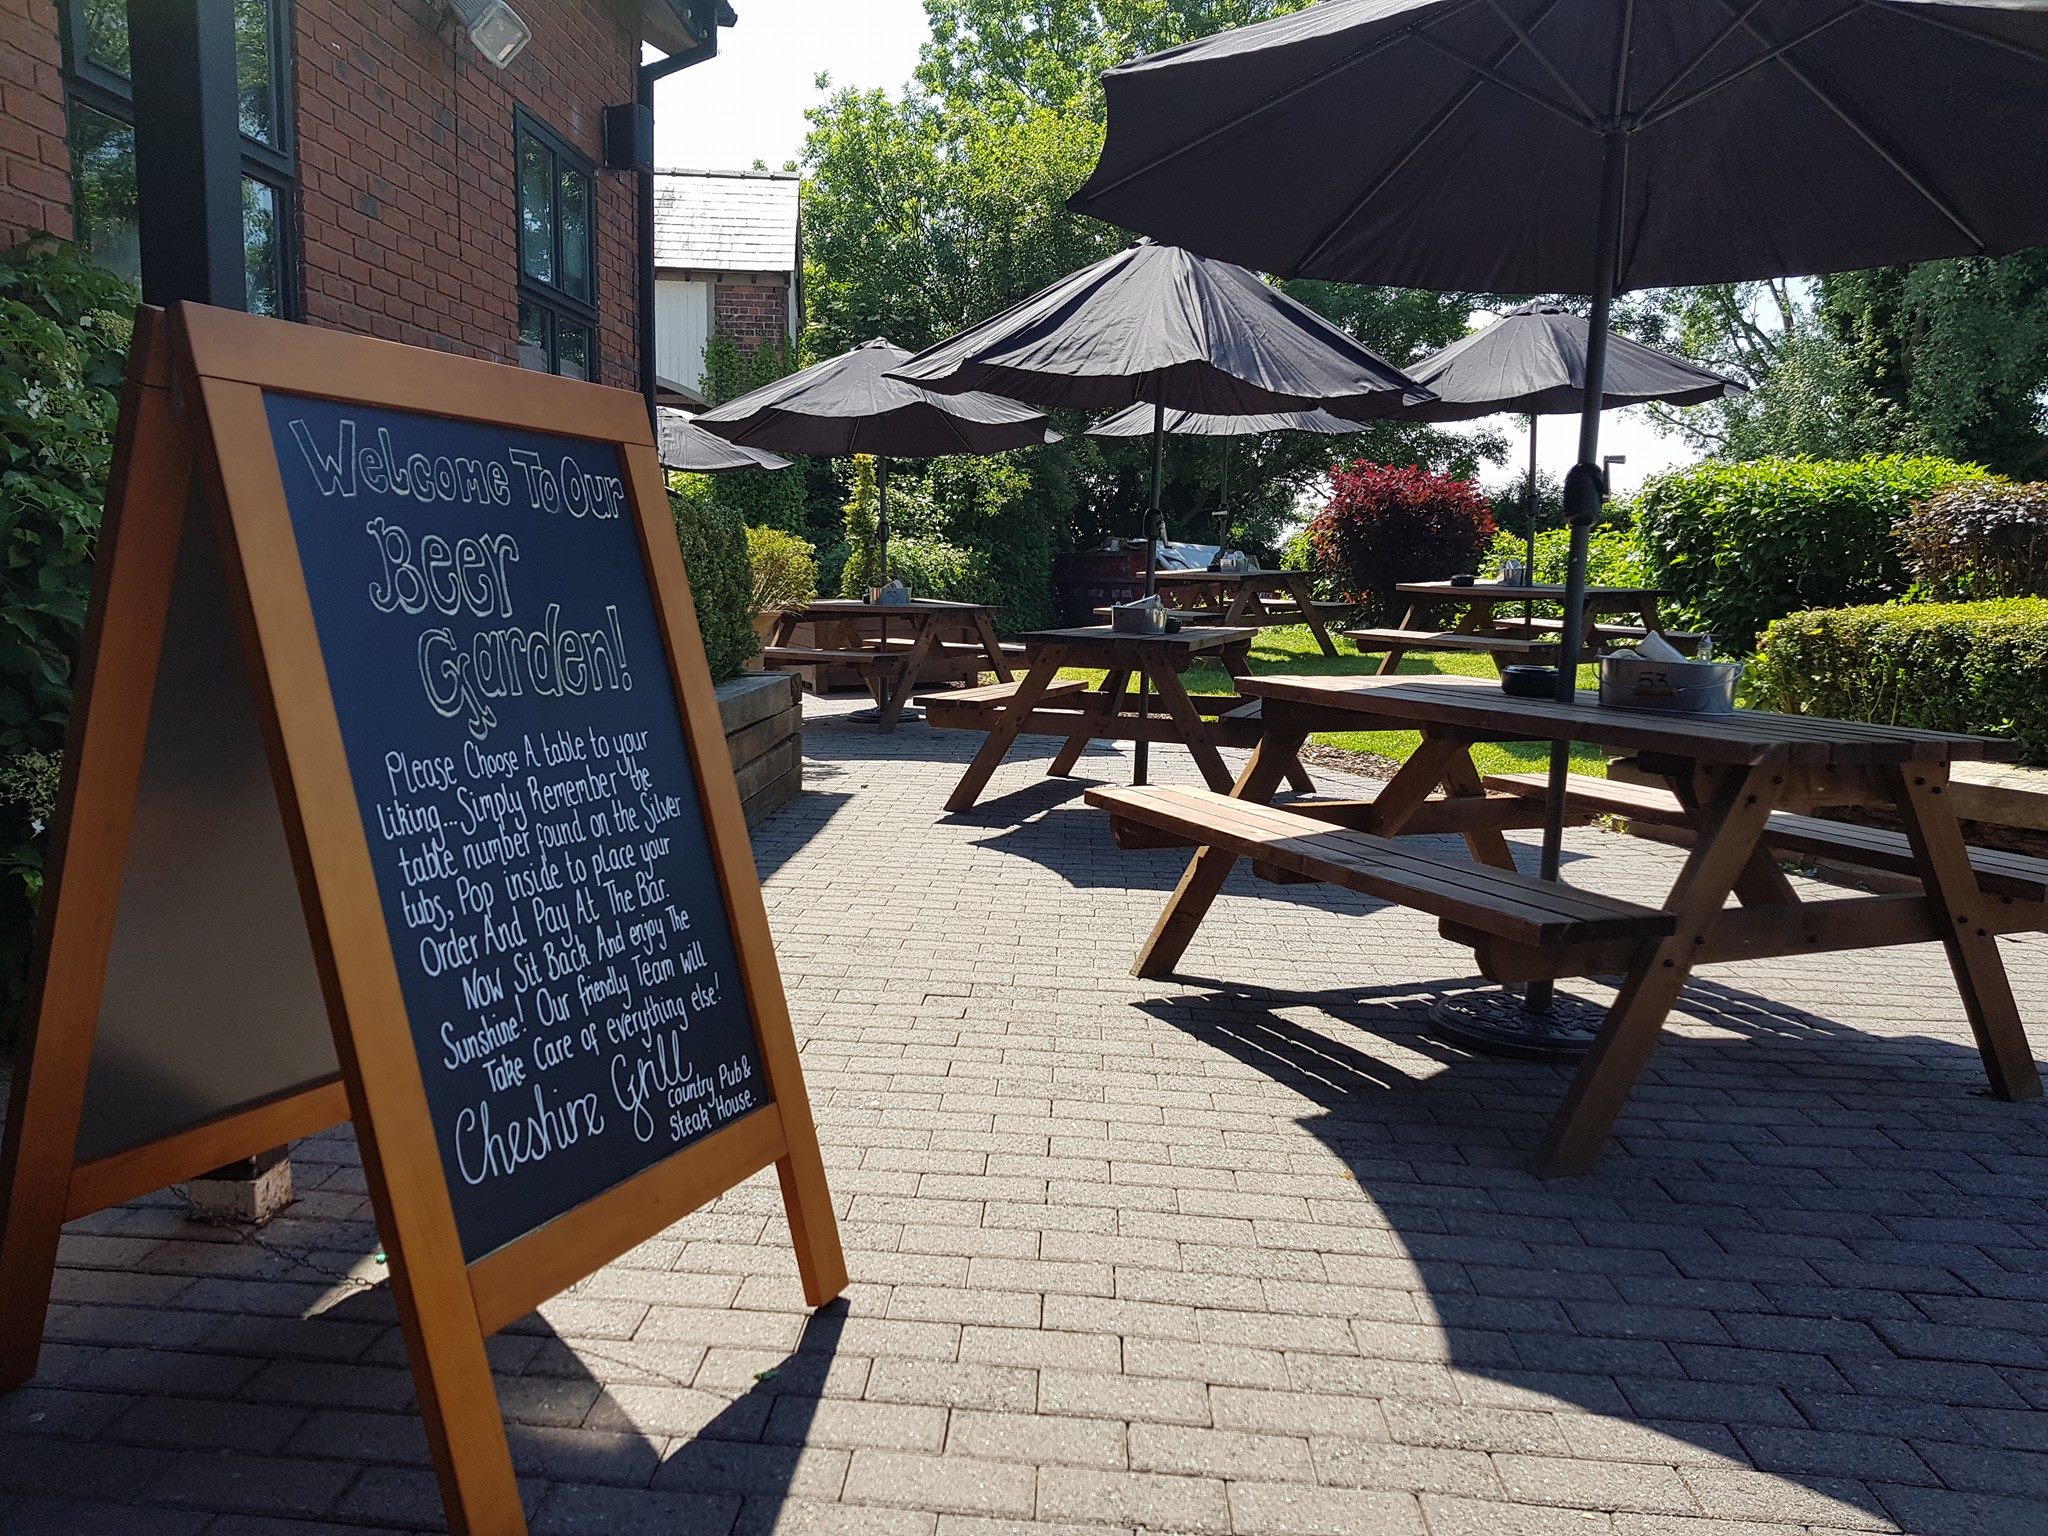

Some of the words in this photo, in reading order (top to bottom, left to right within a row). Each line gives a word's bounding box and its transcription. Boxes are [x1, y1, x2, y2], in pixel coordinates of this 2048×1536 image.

[289, 419, 511, 505] Welcome
[508, 446, 559, 513] To
[560, 456, 624, 519] Our
[366, 517, 520, 618] Beer
[417, 604, 632, 740] Garden!
[385, 750, 457, 796] Please
[463, 740, 519, 779] Choose
[523, 735, 542, 768] A
[540, 729, 588, 768] table
[589, 726, 610, 758] to
[613, 729, 649, 777] your
[457, 783, 528, 836] Simply
[526, 764, 618, 814] Remember
[628, 755, 653, 792] the
[398, 841, 458, 887] table
[462, 824, 531, 870] number
[535, 808, 588, 864] found
[590, 811, 613, 839] on
[612, 799, 641, 834] the
[640, 791, 682, 834] Silver
[401, 888, 454, 933] tubs,
[456, 875, 495, 918] Pop
[502, 859, 564, 901] inside
[565, 850, 588, 885] to
[591, 845, 637, 887] place
[640, 837, 671, 880] your
[419, 928, 480, 978] Order
[483, 904, 528, 956] And
[532, 896, 574, 948] Pay
[576, 887, 601, 926] At
[602, 879, 635, 917] The
[634, 870, 671, 909] Bar.
[512, 949, 543, 994] Sit
[542, 933, 592, 981] Back
[596, 921, 627, 963] And
[628, 913, 667, 956] enjoy
[664, 904, 692, 932] The
[439, 993, 528, 1071] Sunshine!
[535, 986, 572, 1027] Our
[577, 965, 632, 1017] friendly
[630, 953, 675, 988] Team
[678, 940, 708, 975] will
[481, 1051, 528, 1094] Take
[532, 1035, 575, 1072] Care
[580, 1023, 602, 1057] of
[606, 990, 688, 1050] everything
[691, 971, 723, 1013] else!
[454, 1082, 606, 1185] Cheshire
[610, 1029, 694, 1143] Grill
[669, 1110, 713, 1143] Steak
